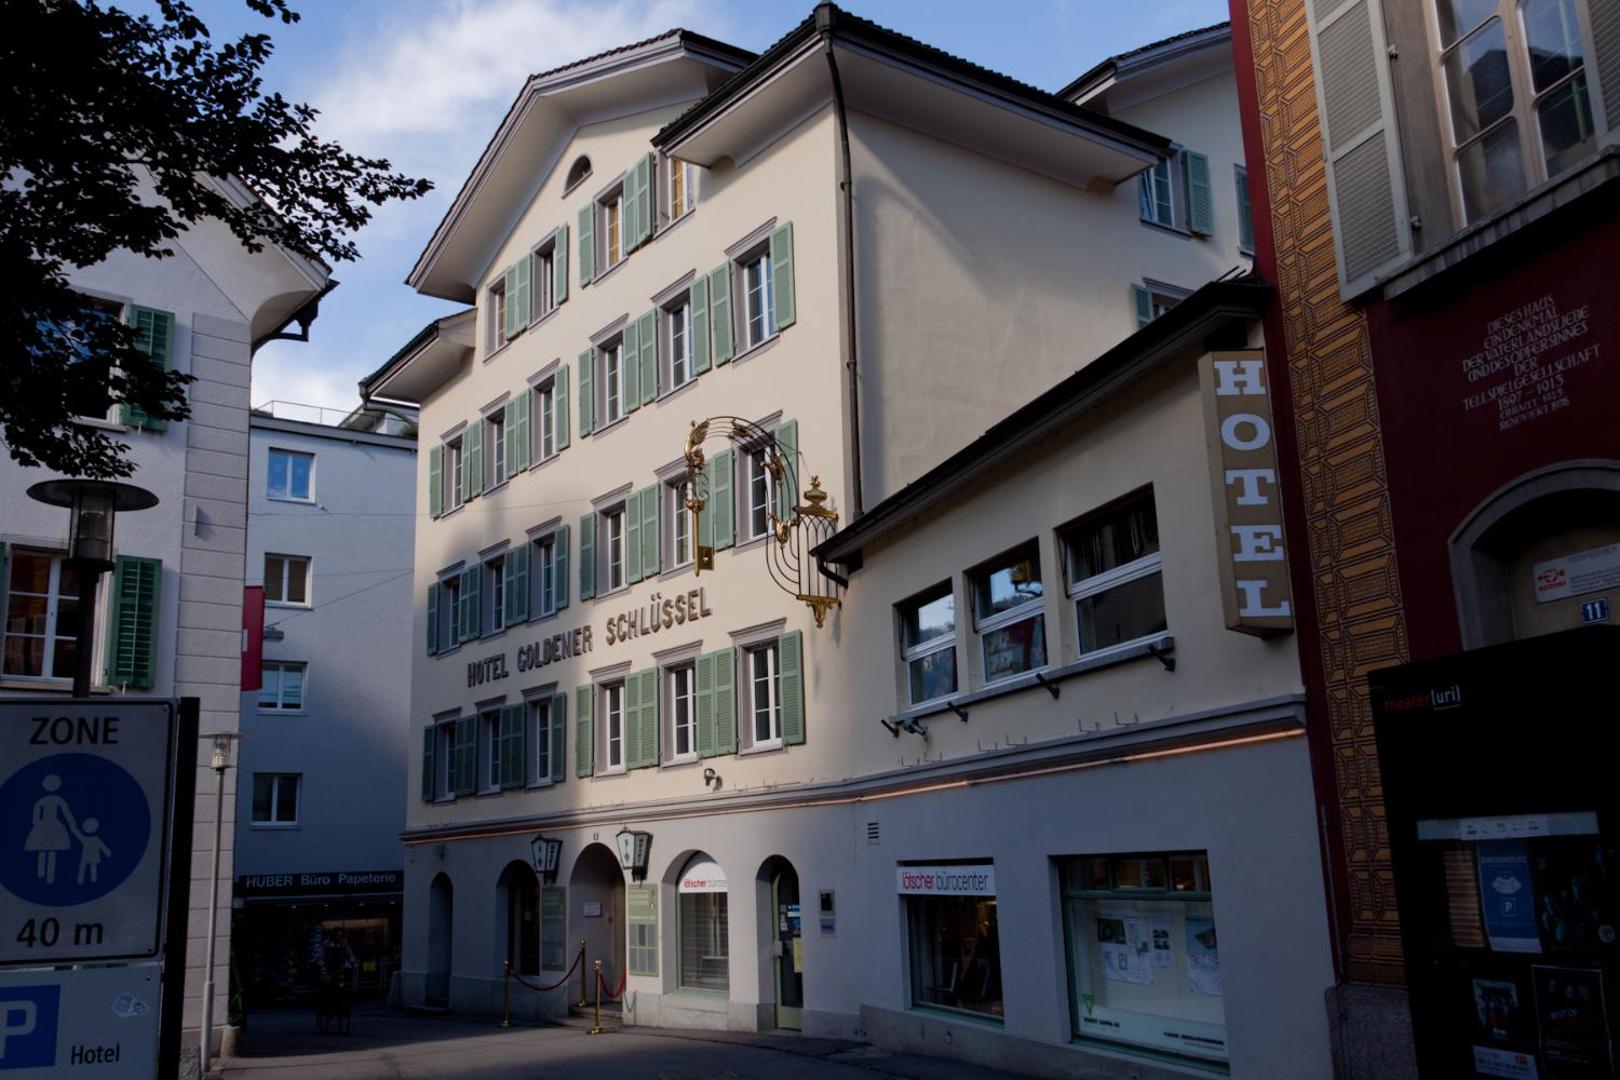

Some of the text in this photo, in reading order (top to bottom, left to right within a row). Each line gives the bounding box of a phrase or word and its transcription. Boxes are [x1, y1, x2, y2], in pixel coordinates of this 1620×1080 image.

[1487, 294, 1553, 333] DIESES HAUS
[1503, 305, 1559, 341] DENKMAL
[1462, 306, 1590, 372] DER VATERLANDSLIEBE
[1462, 343, 1600, 411] TELLSPIELGESELLSCHAFT
[1468, 363, 1490, 383] UND
[1491, 354, 1510, 373] DES
[1514, 356, 1537, 376] DER
[1214, 360, 1293, 617] HOTEL
[1587, 602, 1601, 620] 11
[468, 587, 713, 688] HOTEL GOLDENER SCHLÜSSEL
[29, 717, 120, 745] ZONE
[247, 871, 396, 888] HUBER Büro Papeterie
[902, 871, 988, 890] lötscher bürocenter
[16, 918, 104, 947] 40 m
[0, 1000, 38, 1059] P
[71, 1043, 121, 1066] Hotel
